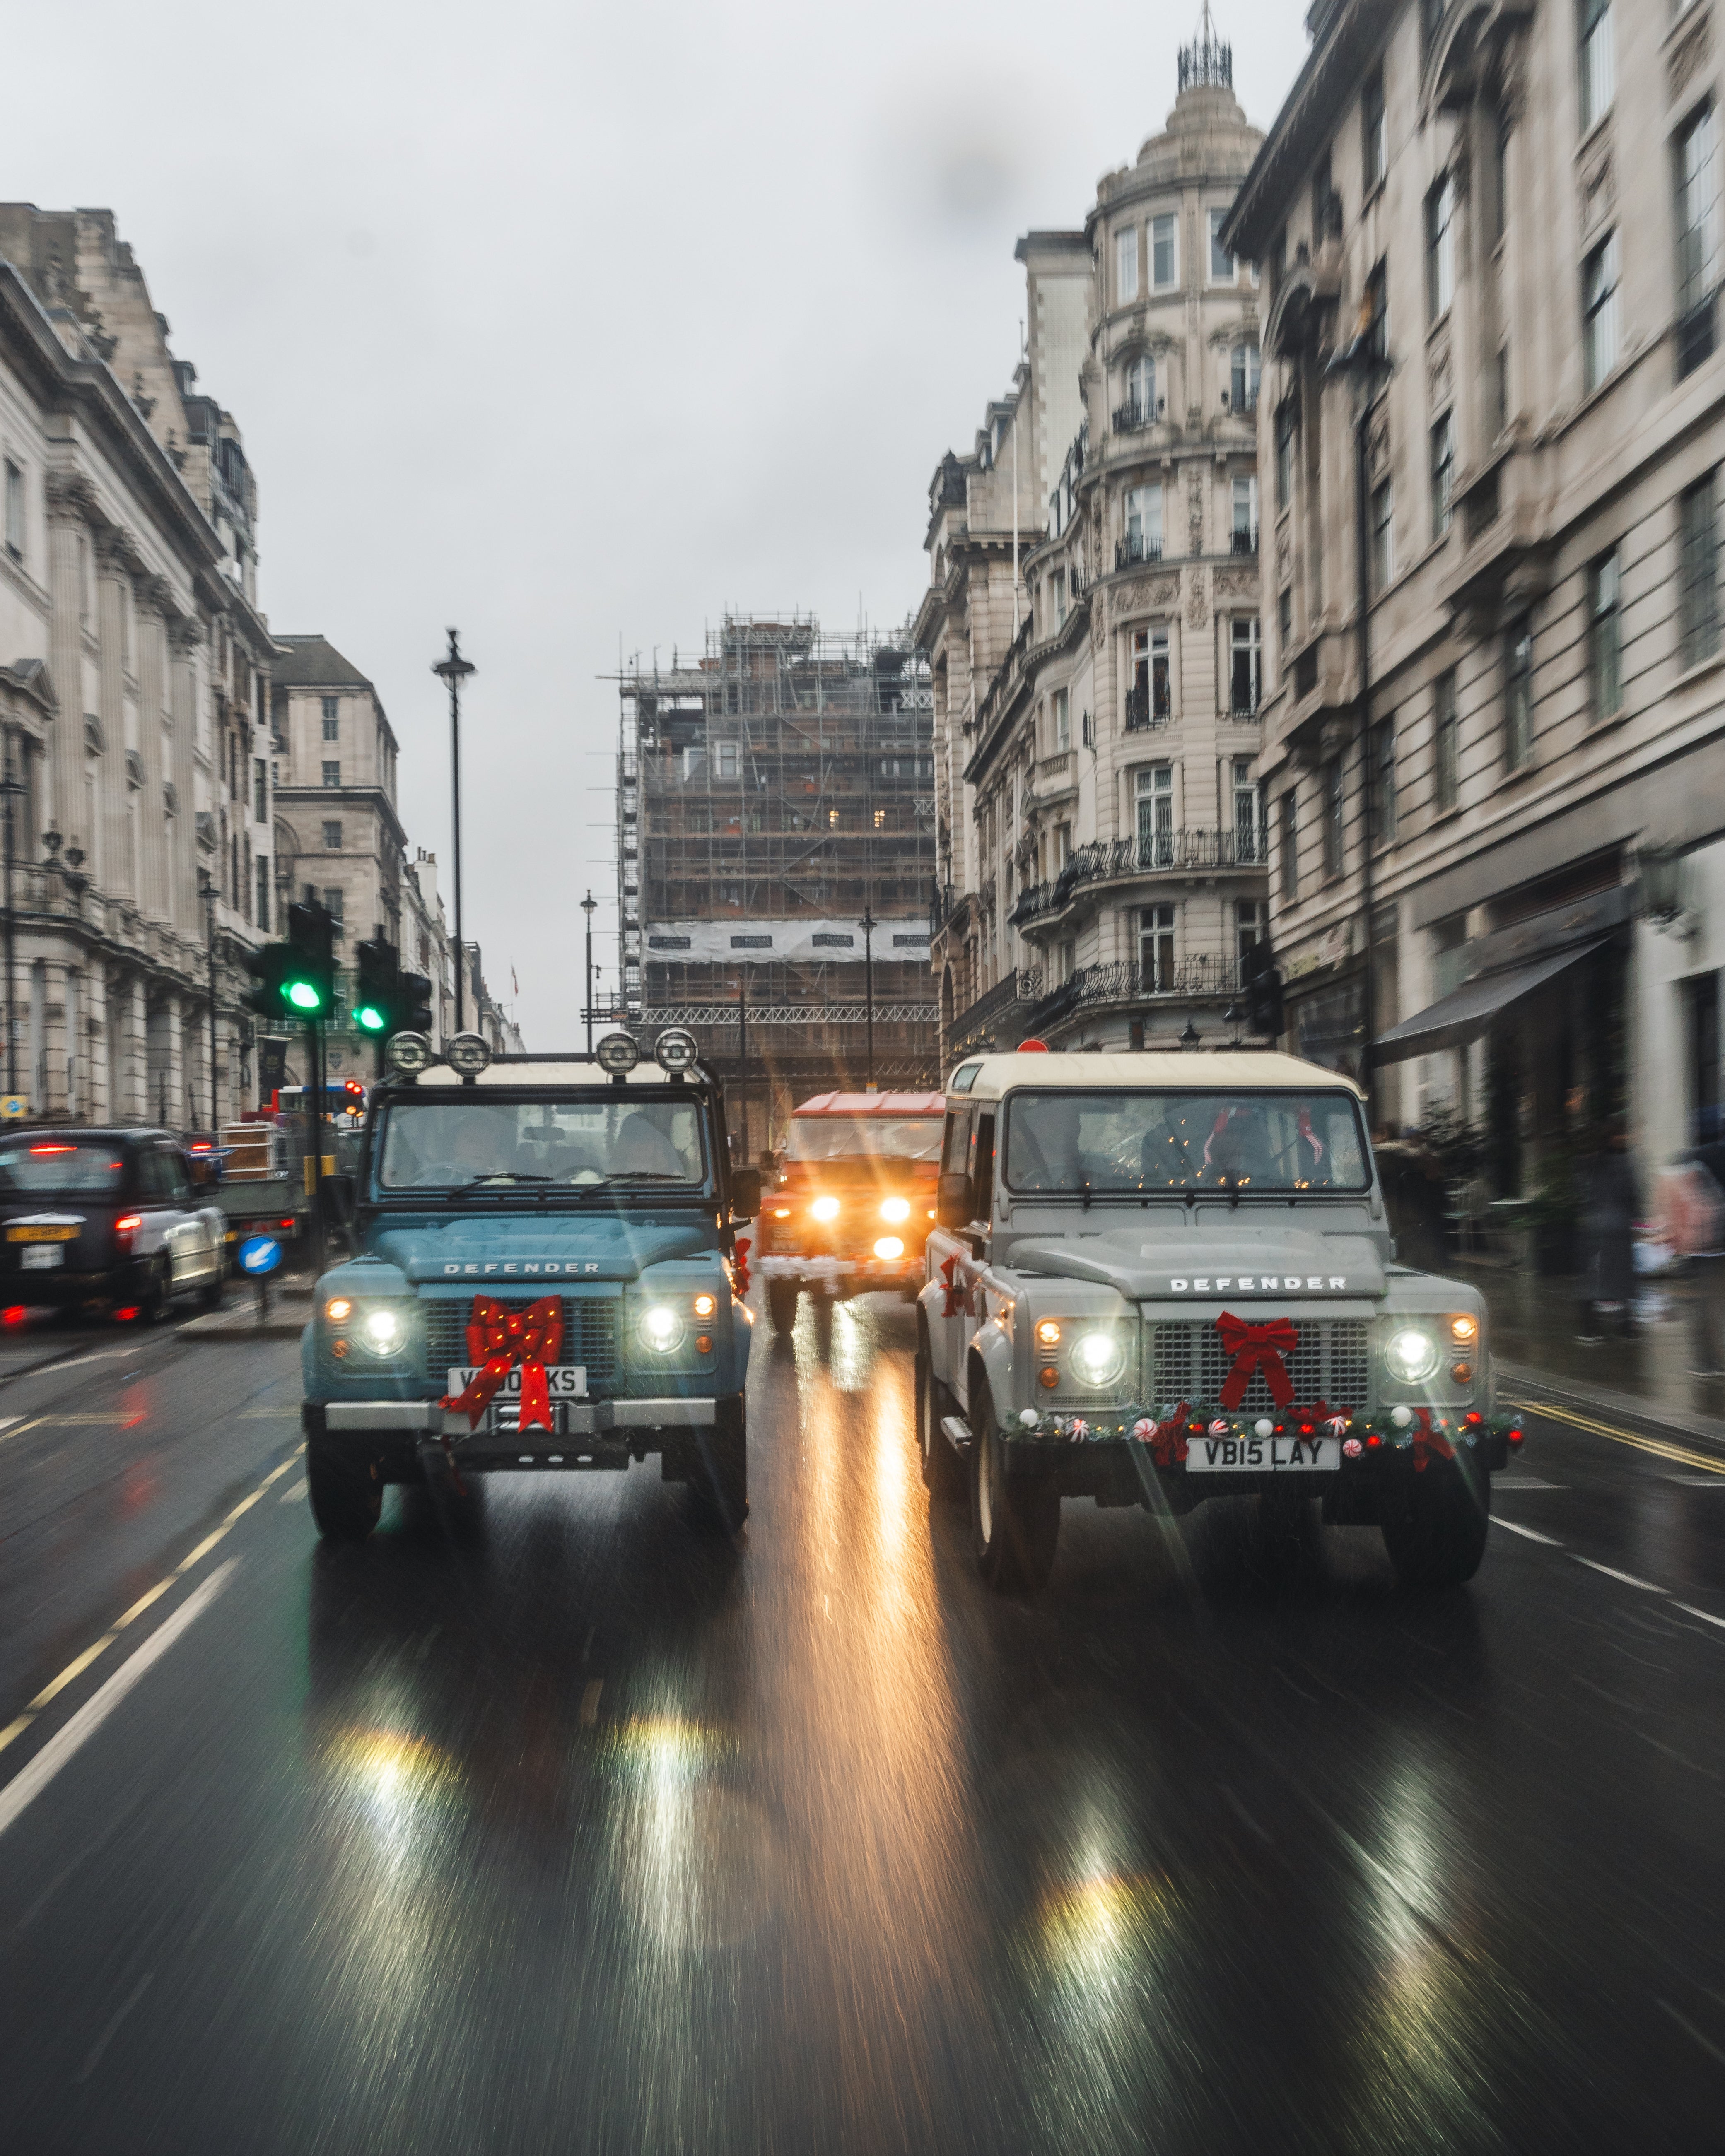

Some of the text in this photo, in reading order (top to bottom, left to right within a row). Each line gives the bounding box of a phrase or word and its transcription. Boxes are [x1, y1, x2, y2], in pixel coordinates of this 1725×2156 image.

[444, 1263, 599, 1274] DEFENDER
[1170, 1276, 1346, 1291] DEFENDER
[1204, 1439, 1322, 1465] VB15 LAY
